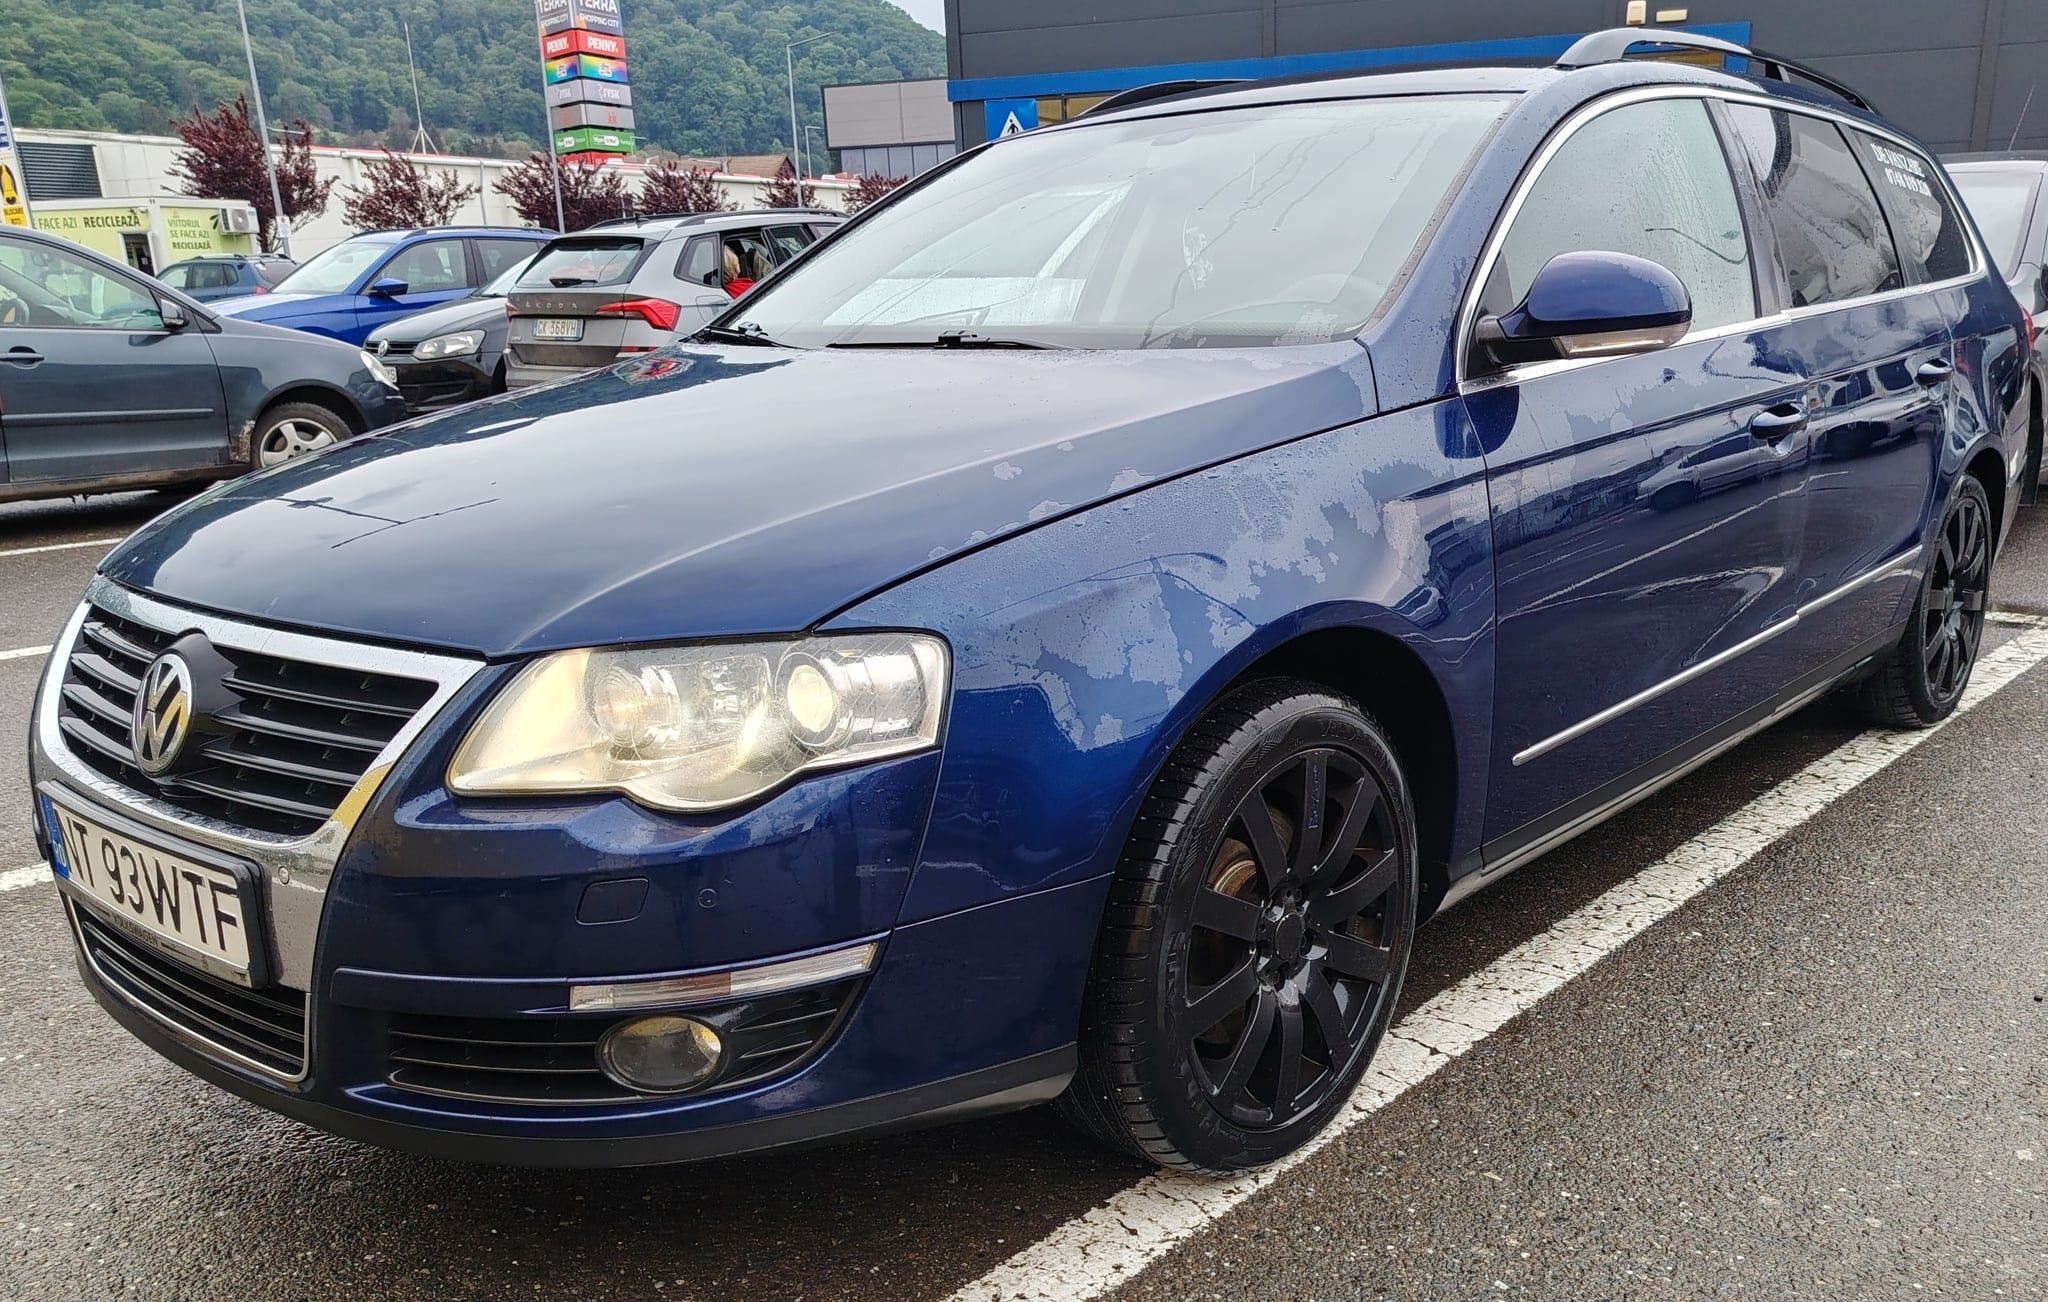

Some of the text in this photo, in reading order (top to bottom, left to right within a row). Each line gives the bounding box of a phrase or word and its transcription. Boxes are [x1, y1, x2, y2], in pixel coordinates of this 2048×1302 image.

[579, 0, 618, 13] TERRA
[607, 19, 619, 28] CITY
[39, 217, 61, 230] FACE
[63, 217, 78, 229] AZI
[83, 214, 141, 228] RECICLEAZĂ
[170, 230, 210, 239] SE FACE AZI
[57, 809, 95, 888] NT
